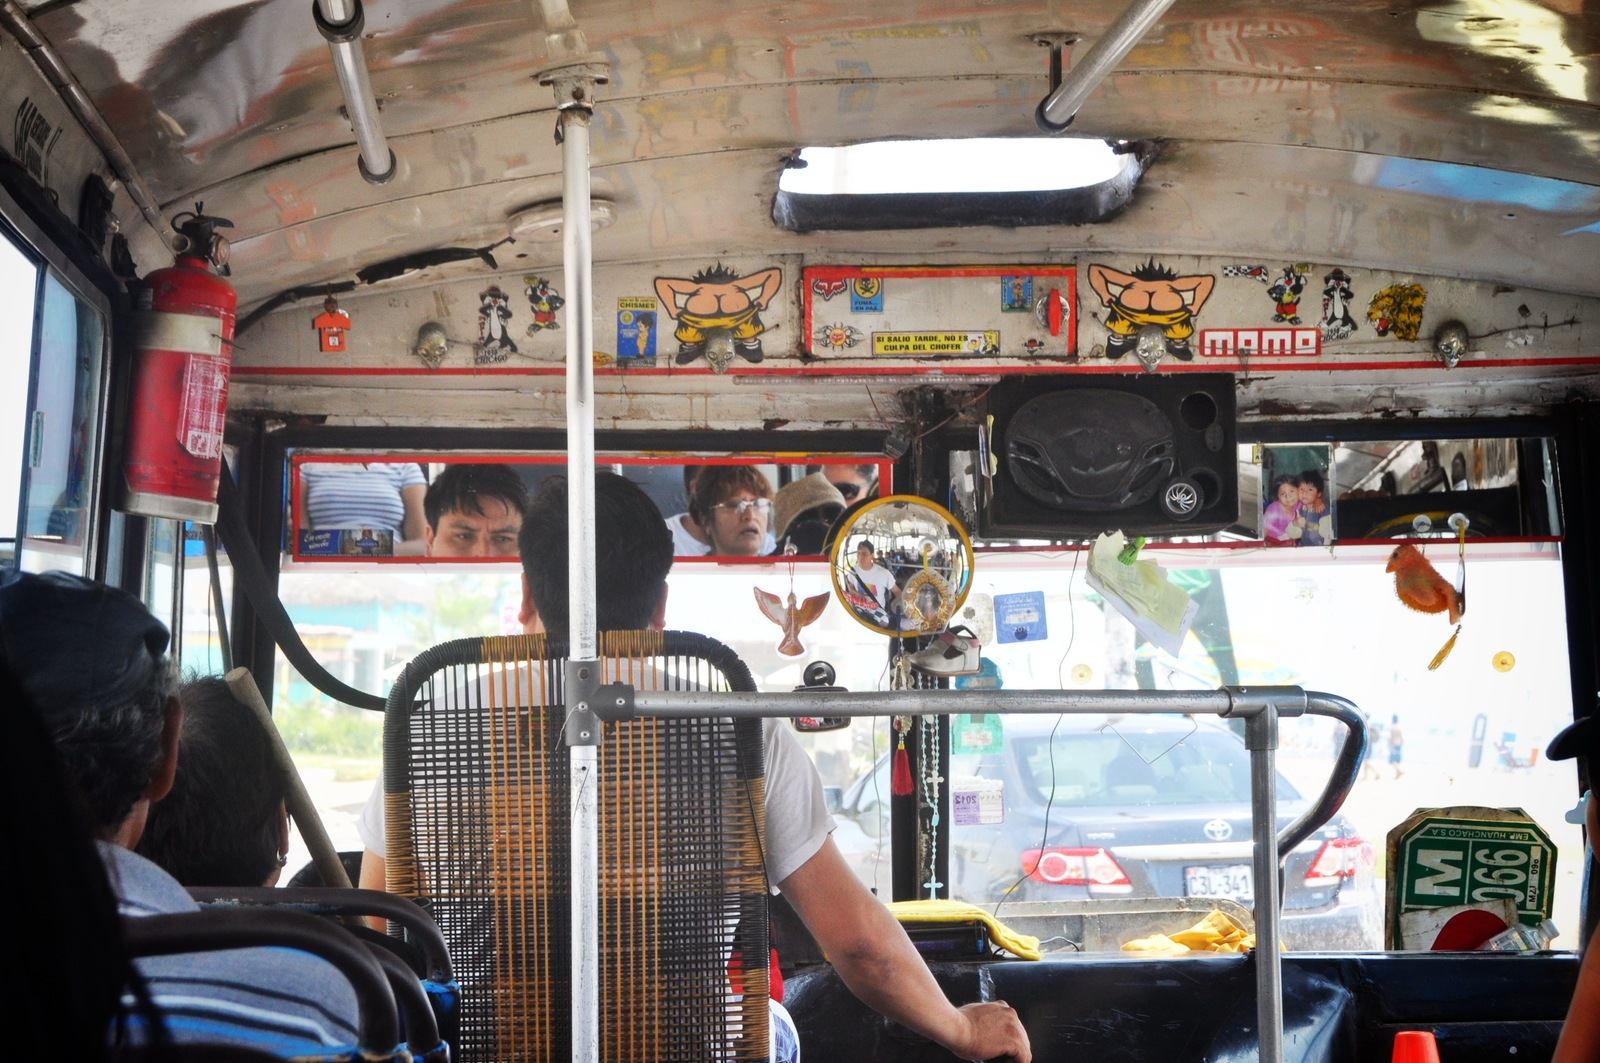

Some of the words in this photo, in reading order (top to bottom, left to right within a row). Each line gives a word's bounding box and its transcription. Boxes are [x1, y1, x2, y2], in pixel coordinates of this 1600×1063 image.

[914, 335, 942, 343] TARDE,
[884, 344, 910, 352] CULPA
[930, 343, 961, 351] CHOFER
[1448, 828, 1507, 840] HUANCHACO
[1414, 848, 1464, 897] M
[1190, 875, 1250, 895] C3L-341
